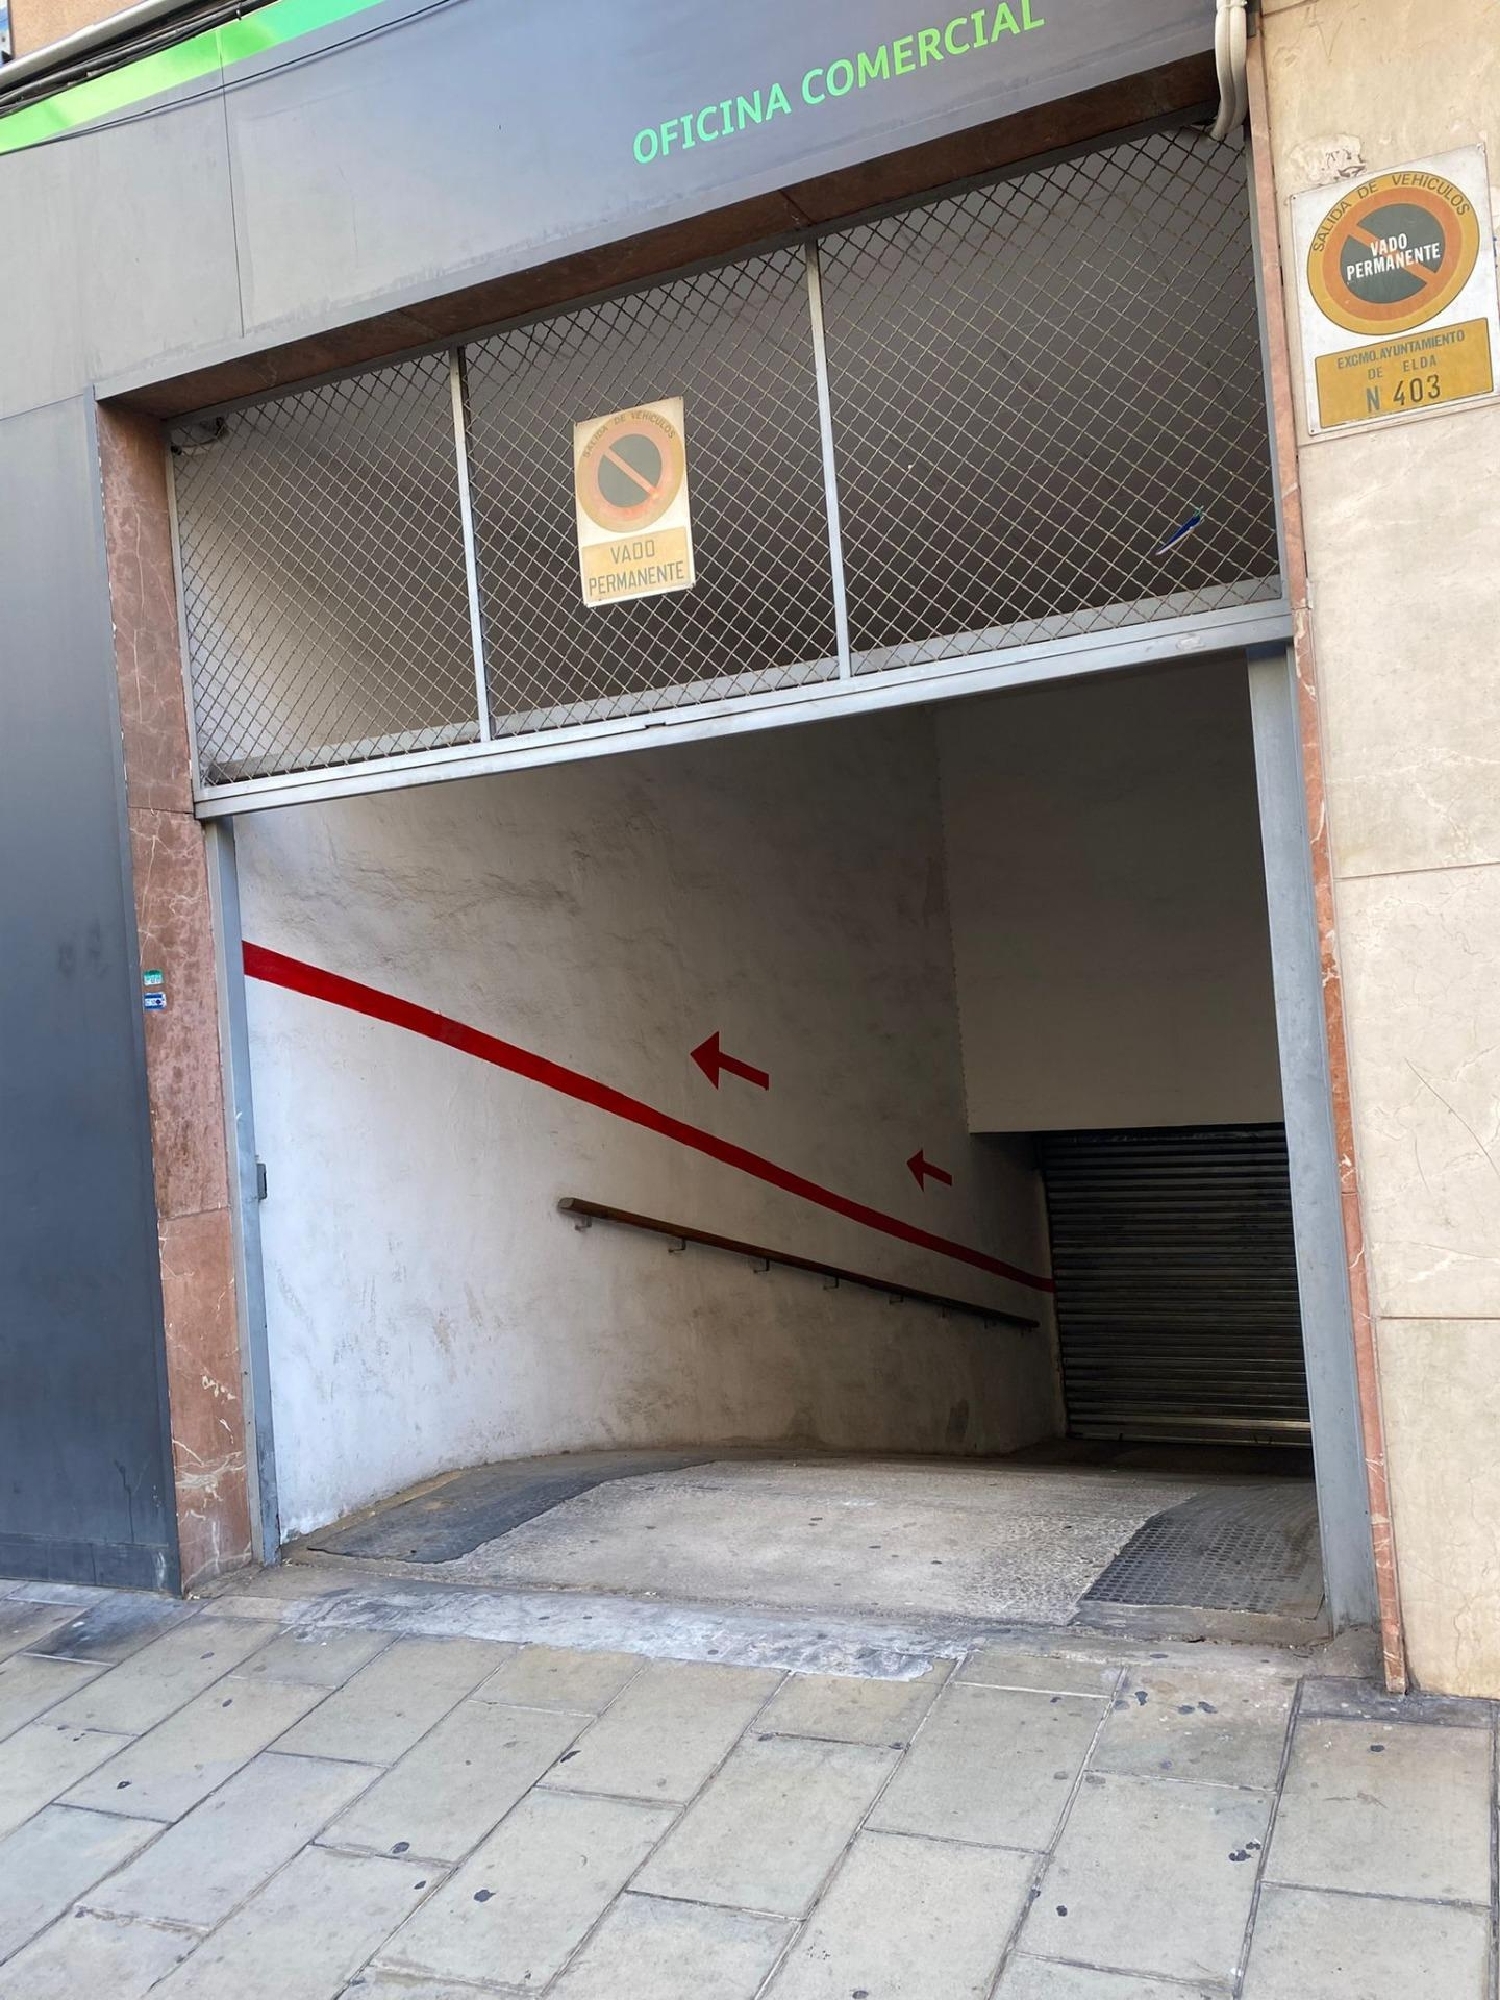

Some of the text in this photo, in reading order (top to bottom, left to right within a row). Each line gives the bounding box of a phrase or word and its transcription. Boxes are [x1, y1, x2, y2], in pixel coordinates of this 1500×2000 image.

[632, 0, 1045, 164] OFICINA COMERCIAL
[1313, 173, 1470, 252] SALIDA DE VEHICULOS
[1370, 233, 1408, 256] VADO
[1346, 242, 1441, 281] PERMANENTE
[1368, 355, 1437, 380] DE ELDA
[1393, 374, 1441, 406] 403
[614, 414, 626, 425] DE
[610, 540, 655, 564] VADO
[589, 560, 685, 597] PERMANENTE
